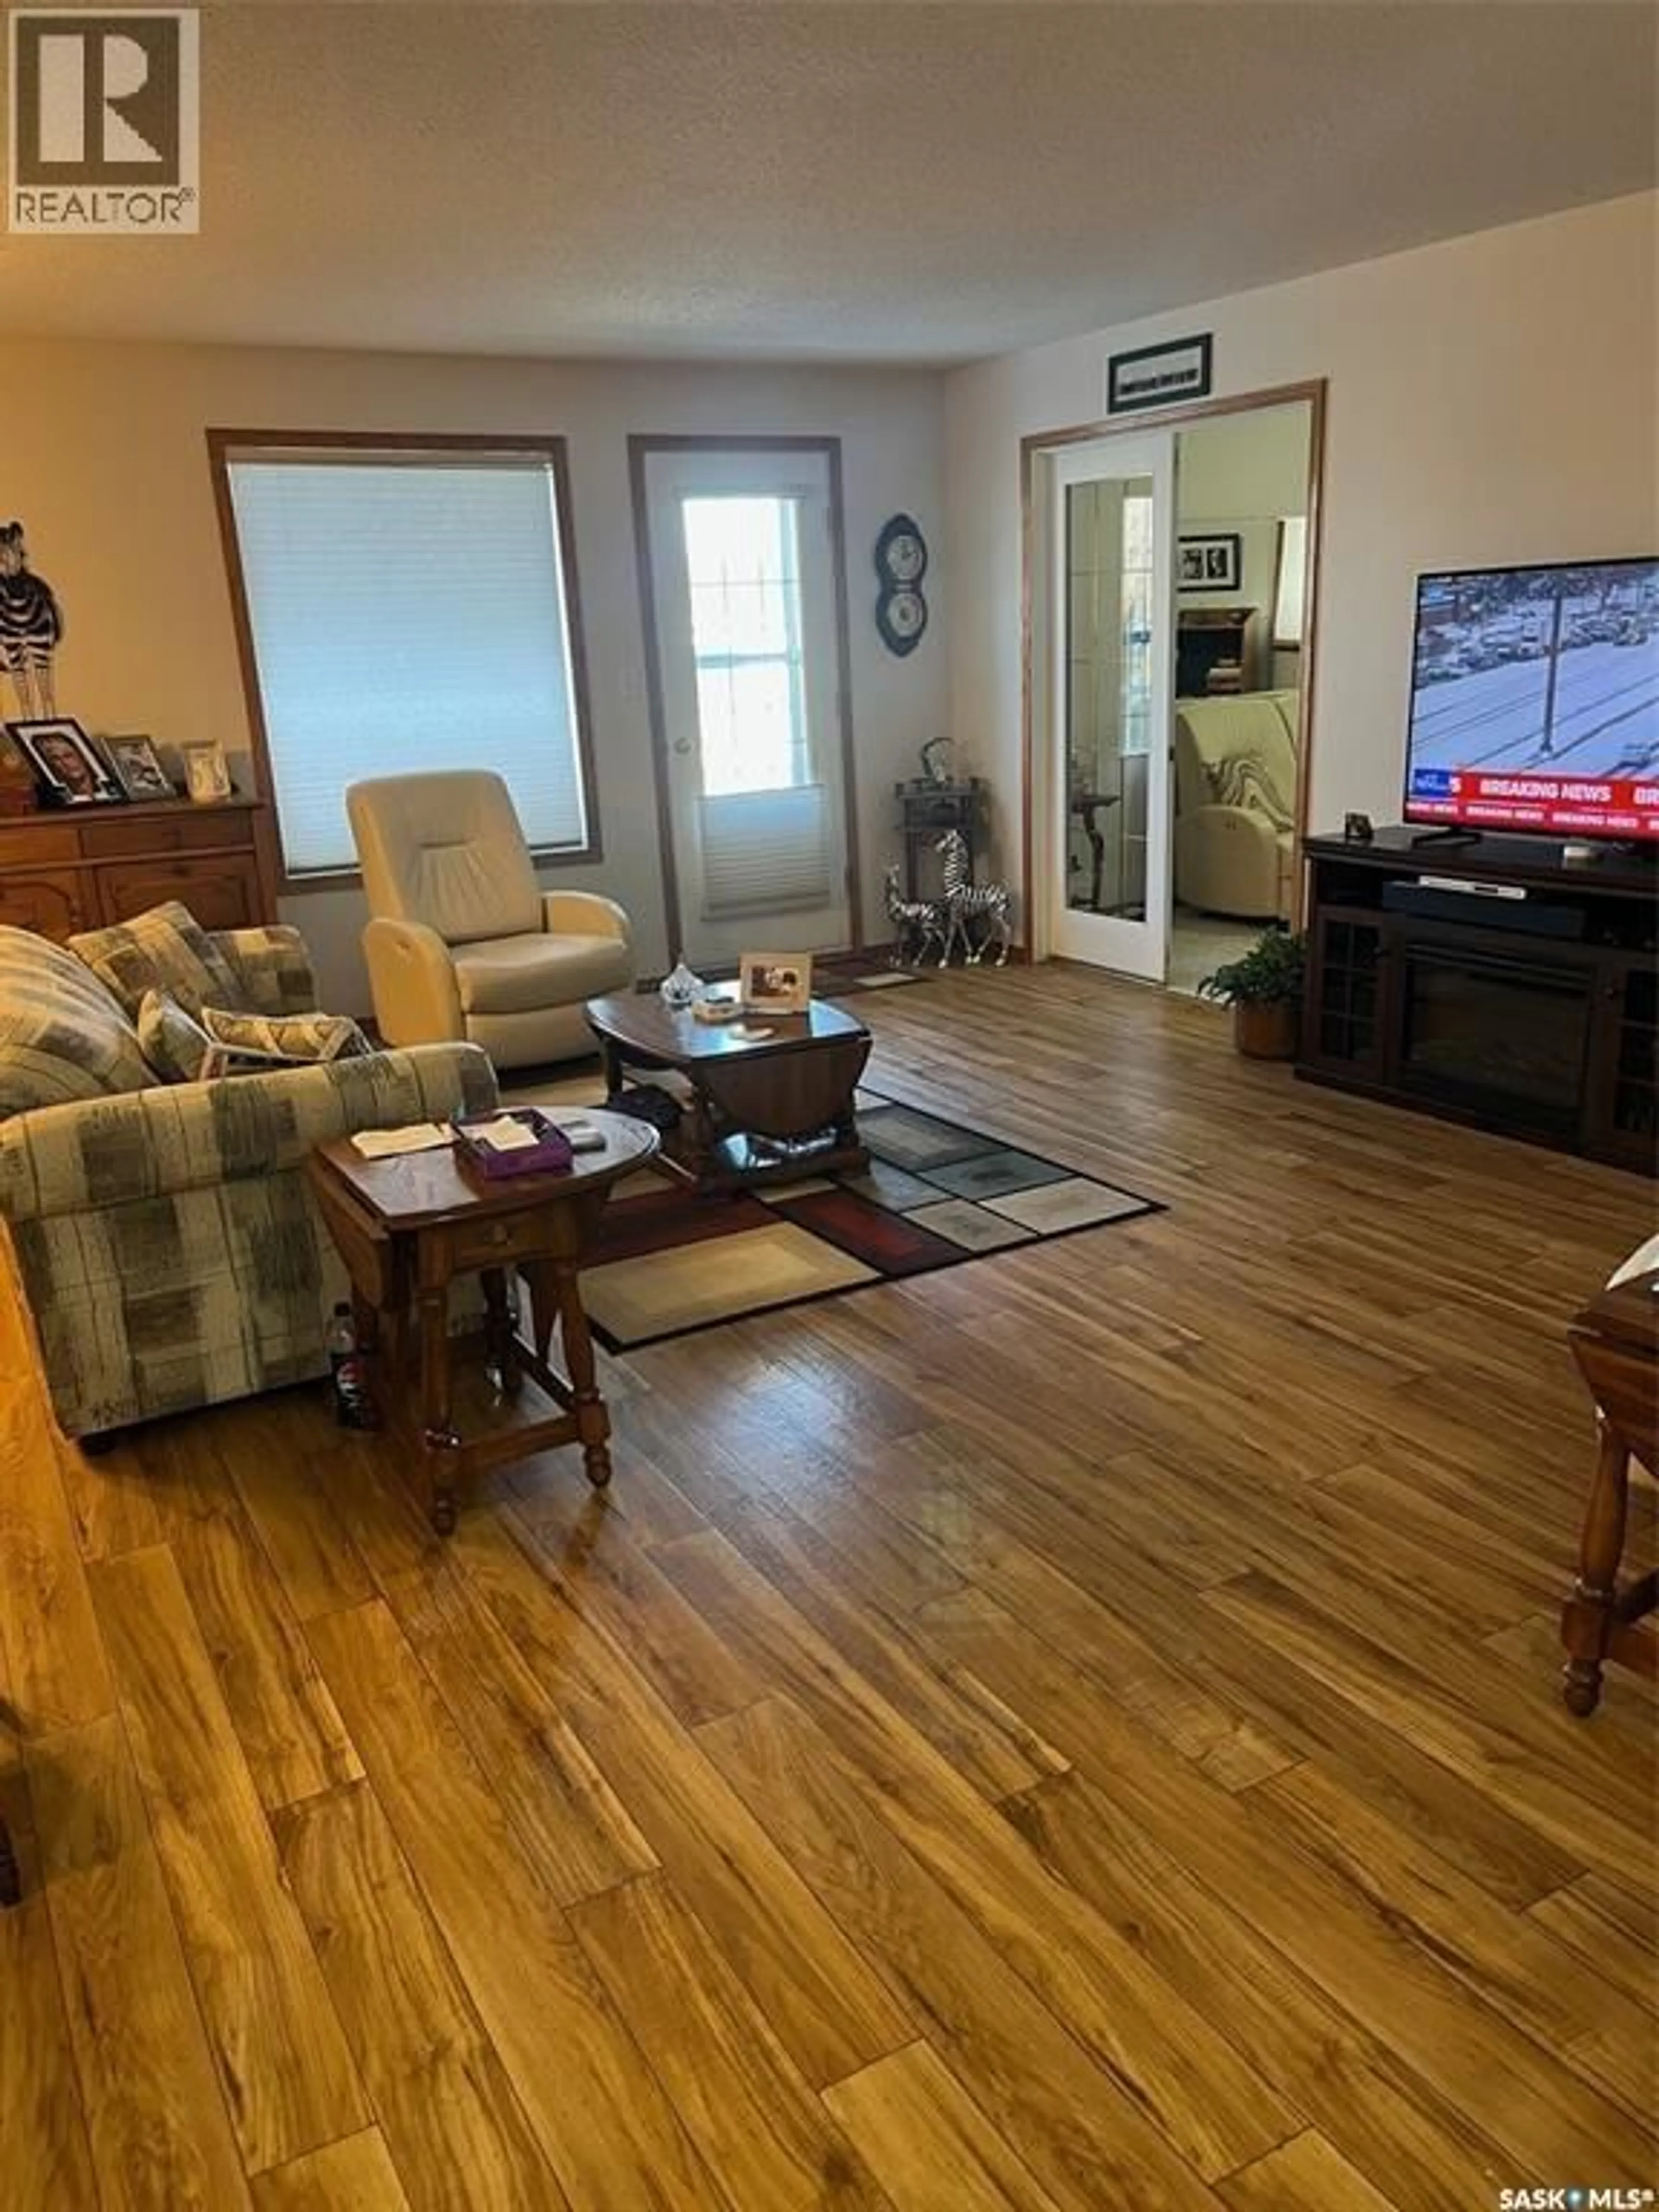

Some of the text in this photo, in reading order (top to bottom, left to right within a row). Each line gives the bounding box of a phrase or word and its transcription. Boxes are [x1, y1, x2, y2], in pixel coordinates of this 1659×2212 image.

[1480, 779, 1612, 802] BREAKING NEWS
[1466, 805, 1544, 820] BREAKING NEWS
[1552, 812, 1605, 825] BREAKING
[1606, 817, 1639, 828] NEWS
